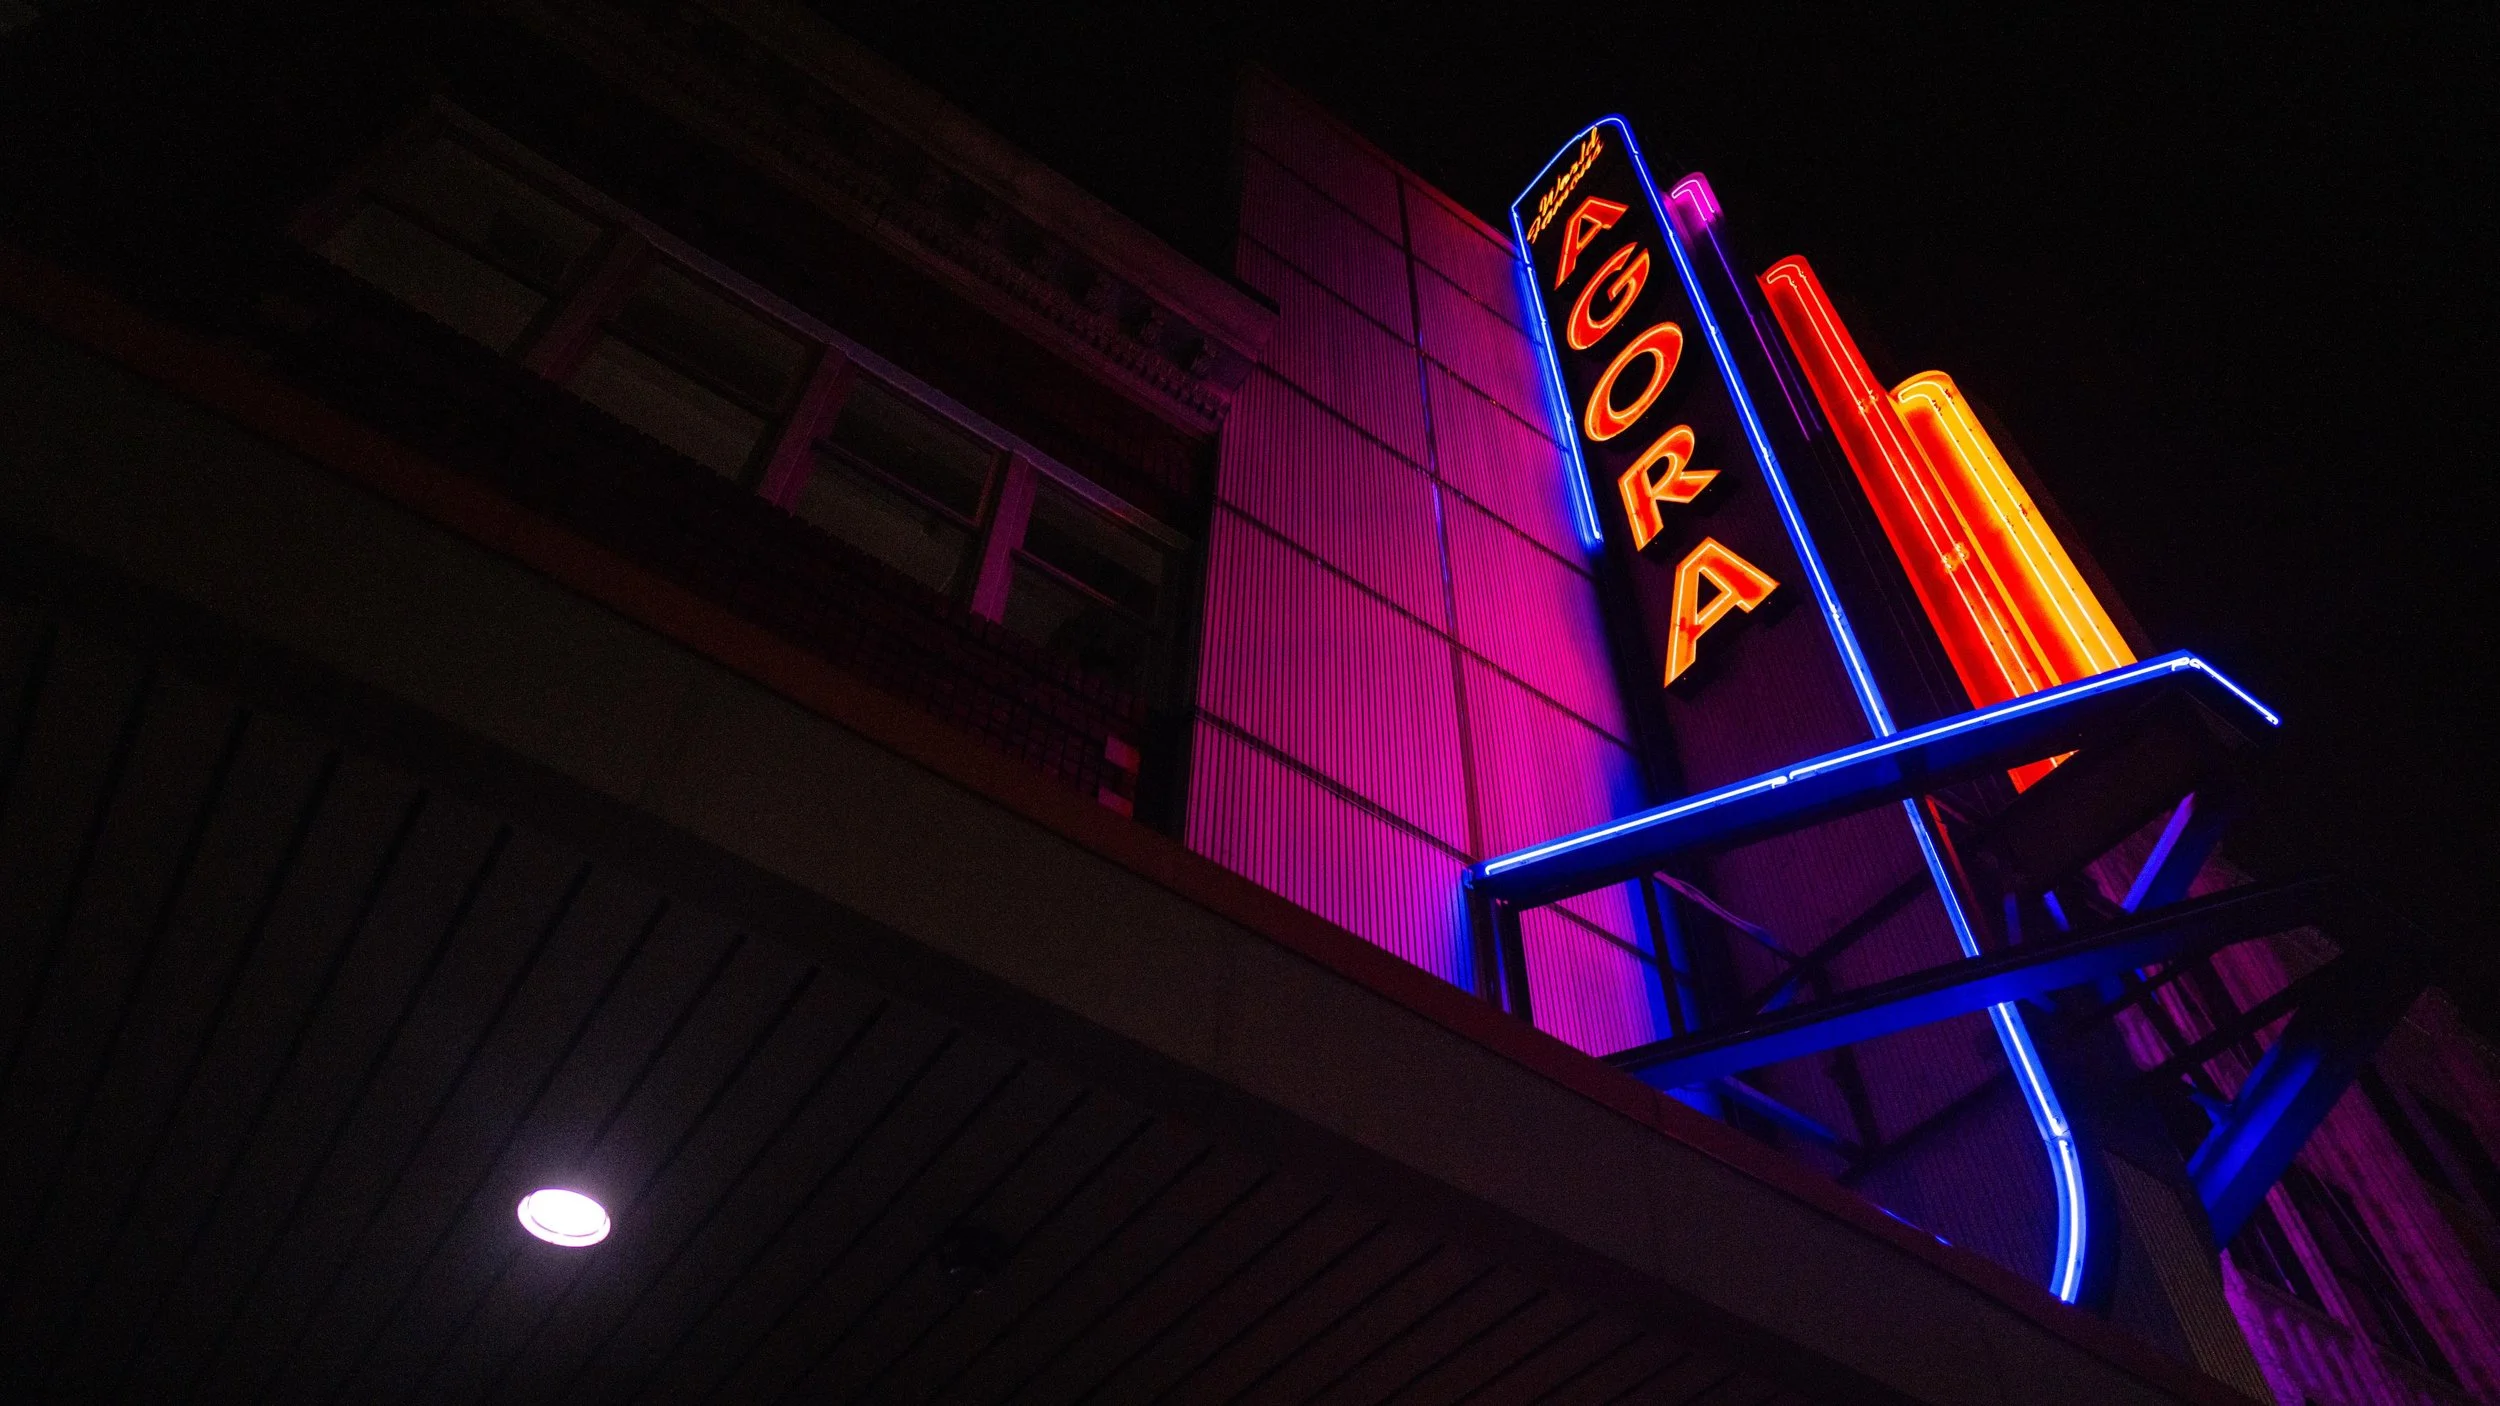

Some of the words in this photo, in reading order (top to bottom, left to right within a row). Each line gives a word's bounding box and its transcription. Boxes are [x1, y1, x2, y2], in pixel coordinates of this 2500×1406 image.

[1527, 141, 1604, 244] Famous
[1538, 126, 1600, 217] World
[1554, 195, 1780, 688] AGORA
